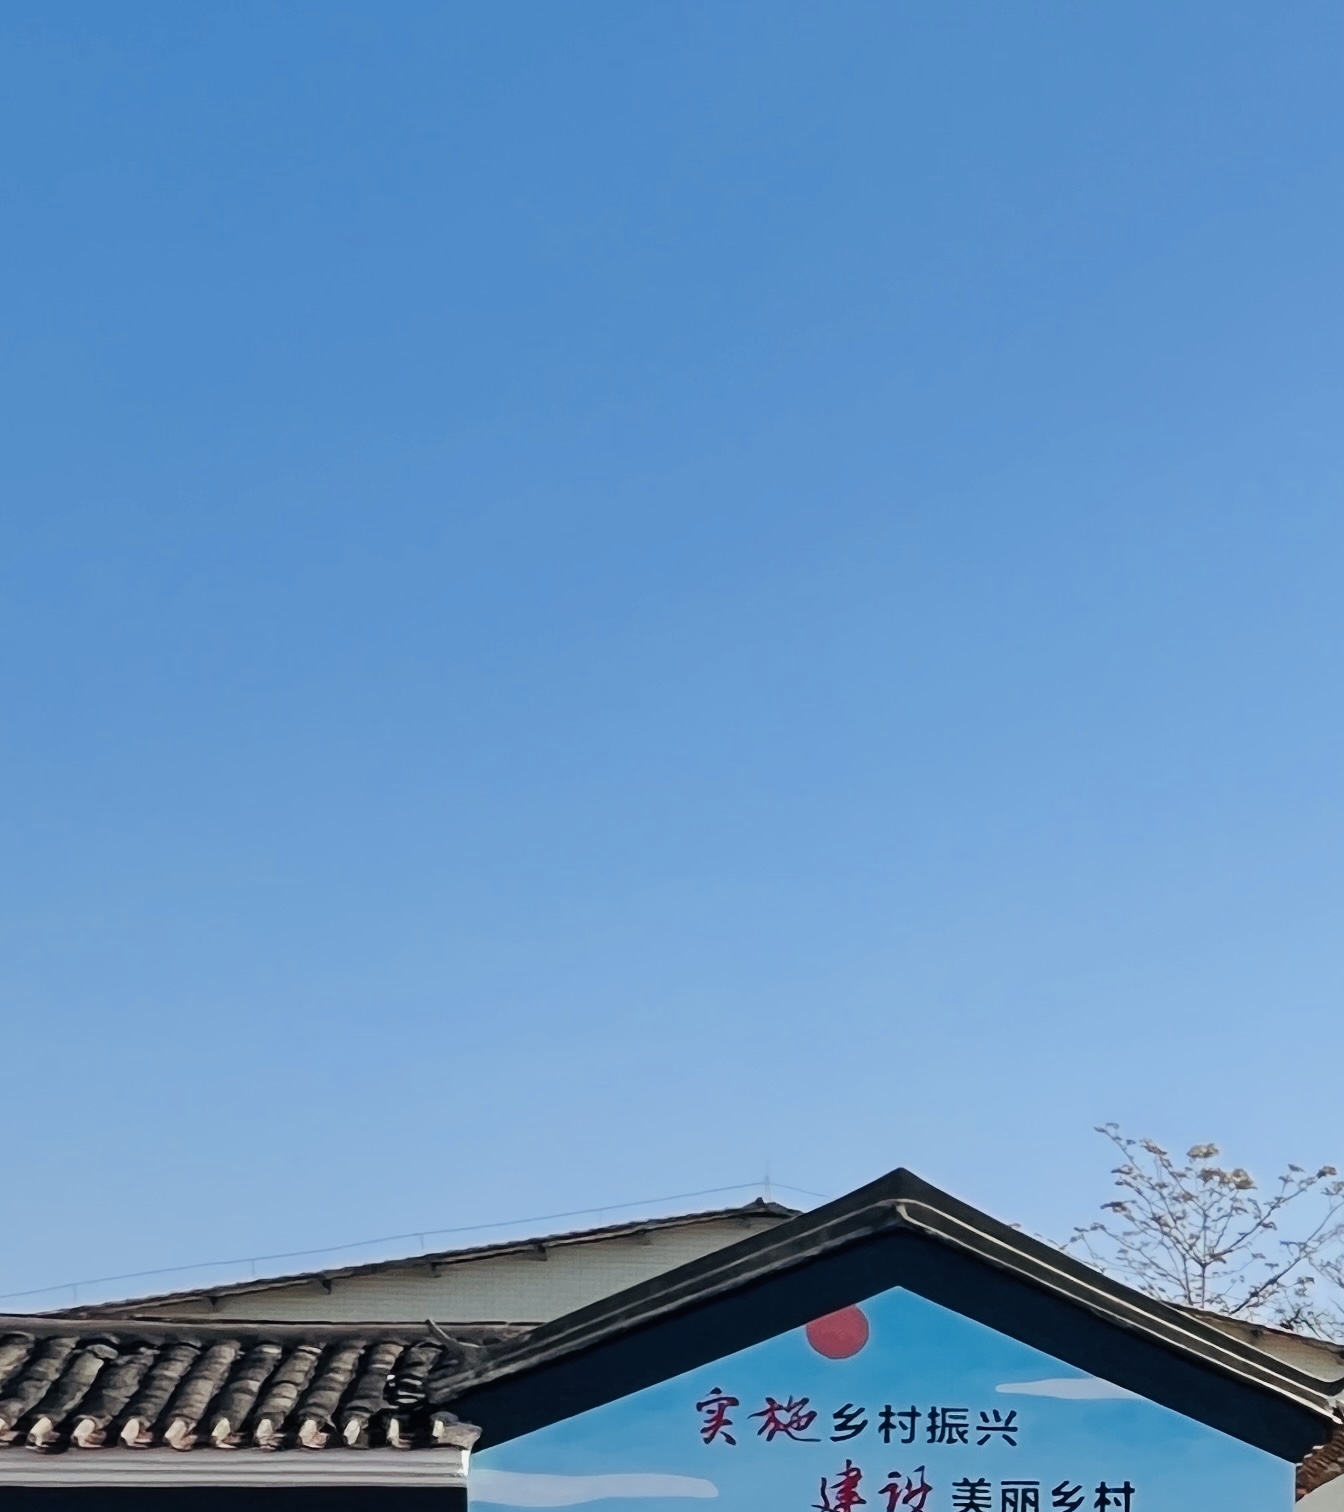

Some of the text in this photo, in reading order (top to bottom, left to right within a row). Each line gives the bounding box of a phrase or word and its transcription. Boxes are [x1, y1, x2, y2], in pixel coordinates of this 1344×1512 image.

[696, 1387, 1018, 1447] 实施乡村振兴
